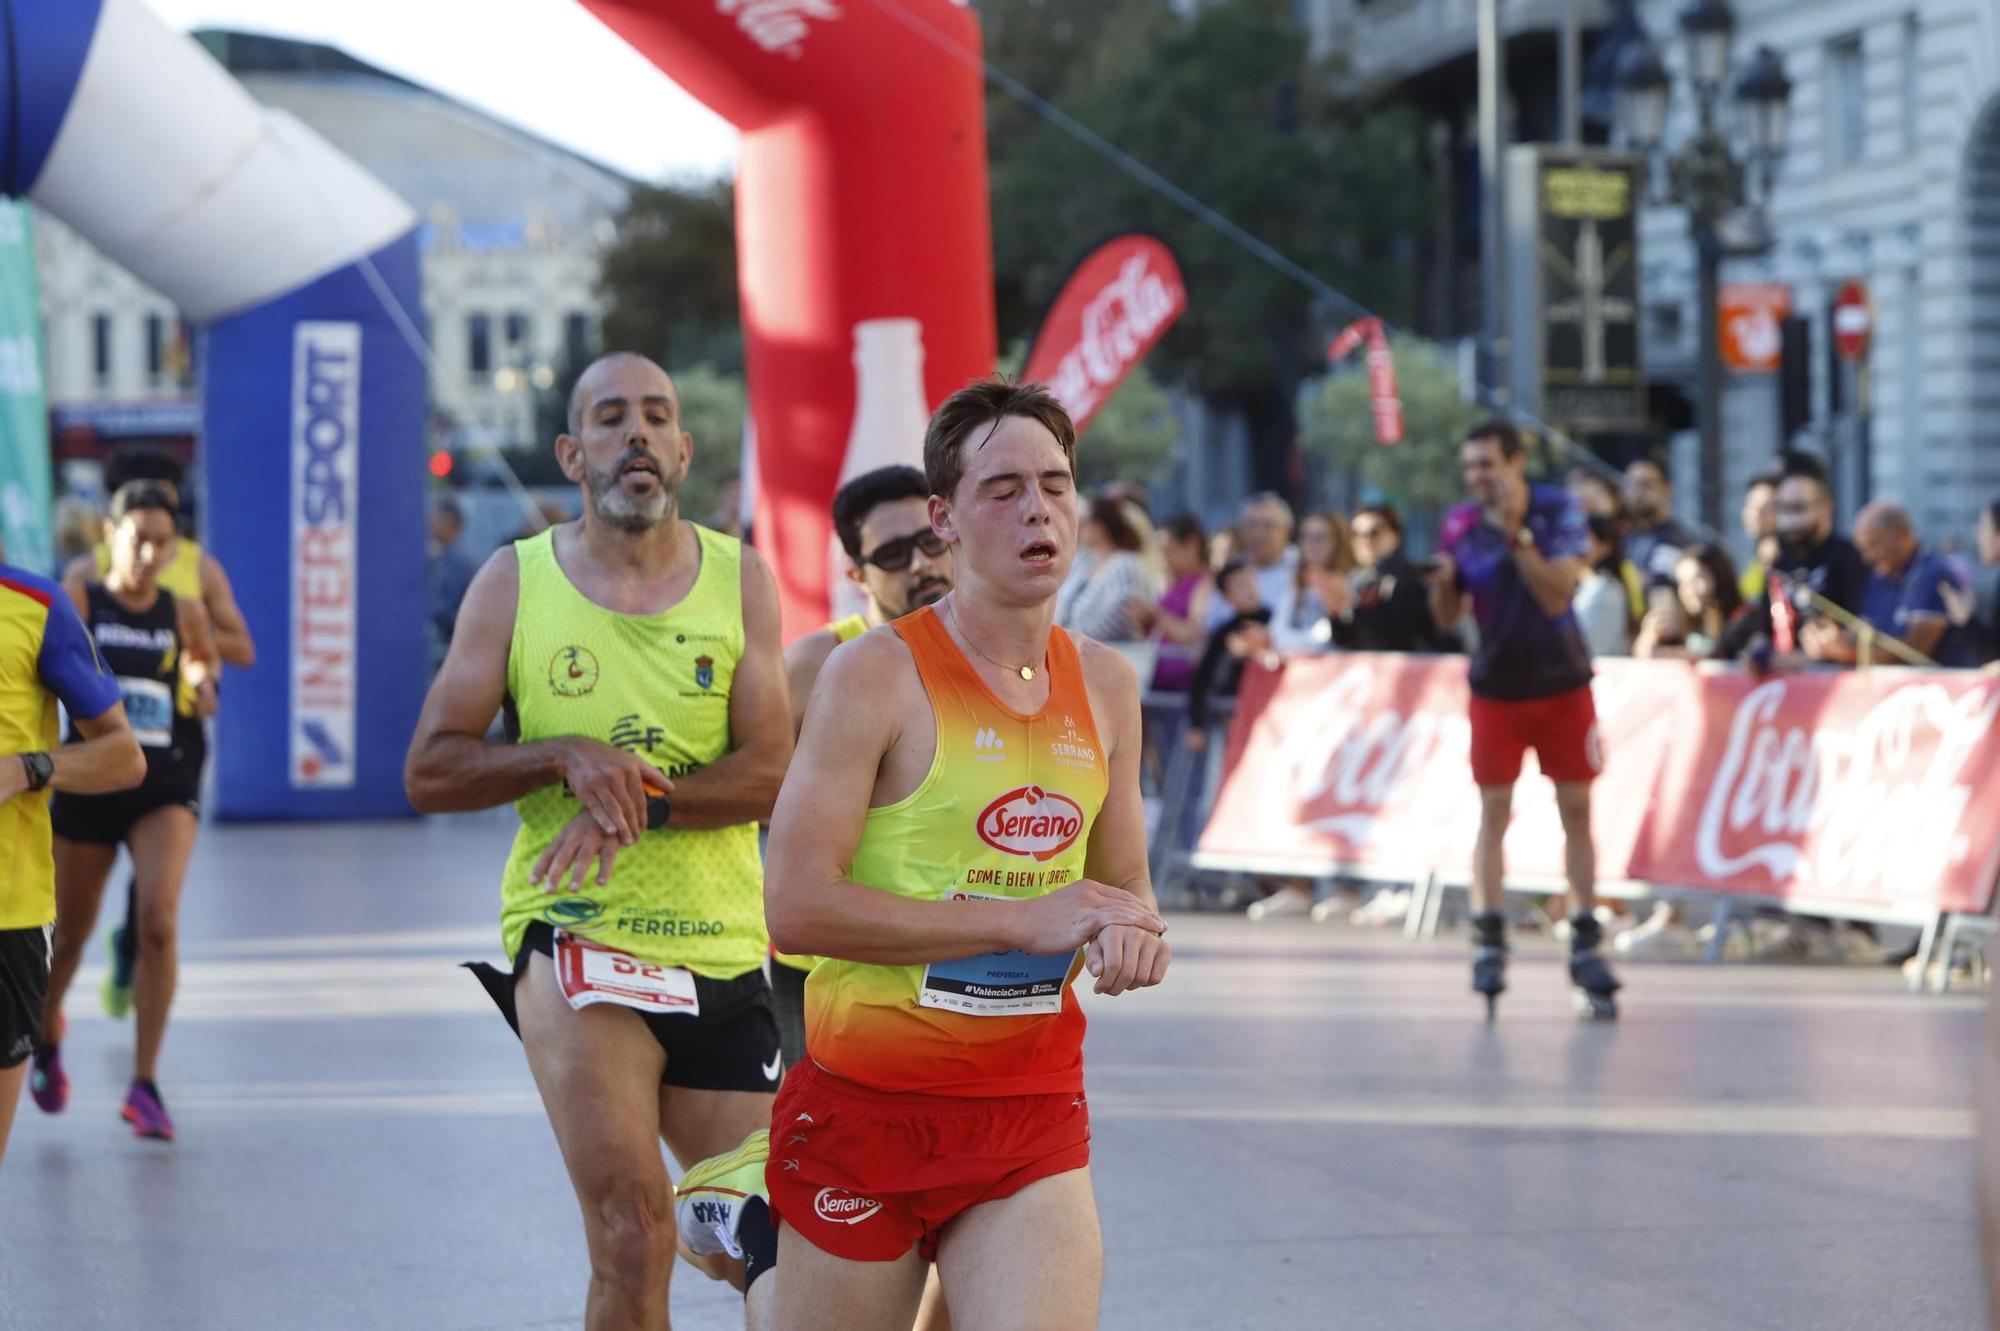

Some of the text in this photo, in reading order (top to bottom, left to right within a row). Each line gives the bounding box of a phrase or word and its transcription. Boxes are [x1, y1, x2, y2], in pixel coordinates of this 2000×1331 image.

[302, 344, 348, 709] INTERSPORT
[1051, 743, 1095, 760] SERRANO
[988, 807, 1078, 838] Serrano
[967, 869, 1002, 885] COME
[1006, 871, 1035, 887] BIEN
[1038, 871, 1046, 886] Y
[617, 917, 724, 937] FERREIRO
[820, 1193, 877, 1213] Serrano
